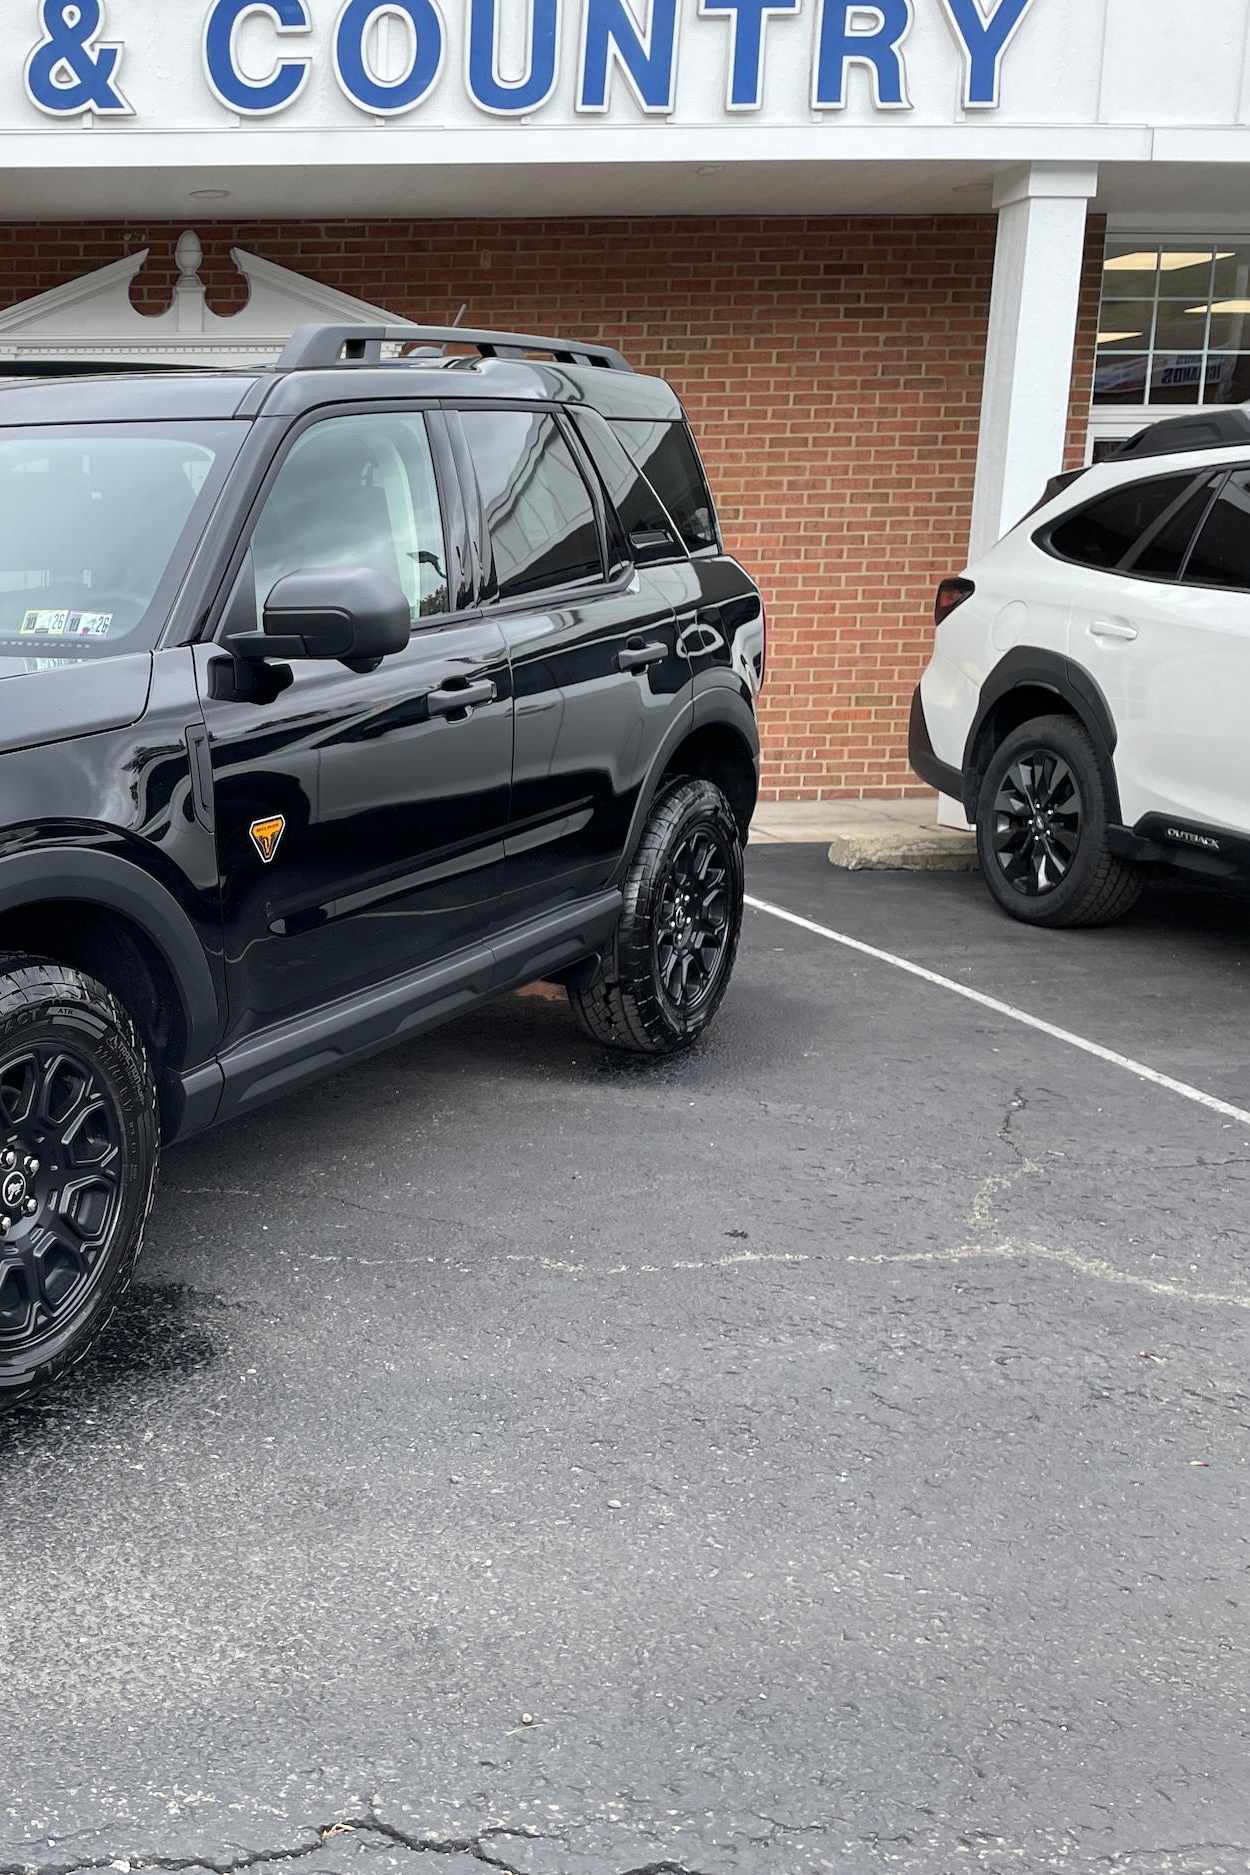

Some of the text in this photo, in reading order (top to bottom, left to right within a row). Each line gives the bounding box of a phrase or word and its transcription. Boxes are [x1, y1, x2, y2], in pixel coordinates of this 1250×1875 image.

[22, 0, 138, 119] &
[201, 0, 1034, 117] COUNTRY
[52, 613, 65, 630] 26
[96, 616, 110, 634] 26
